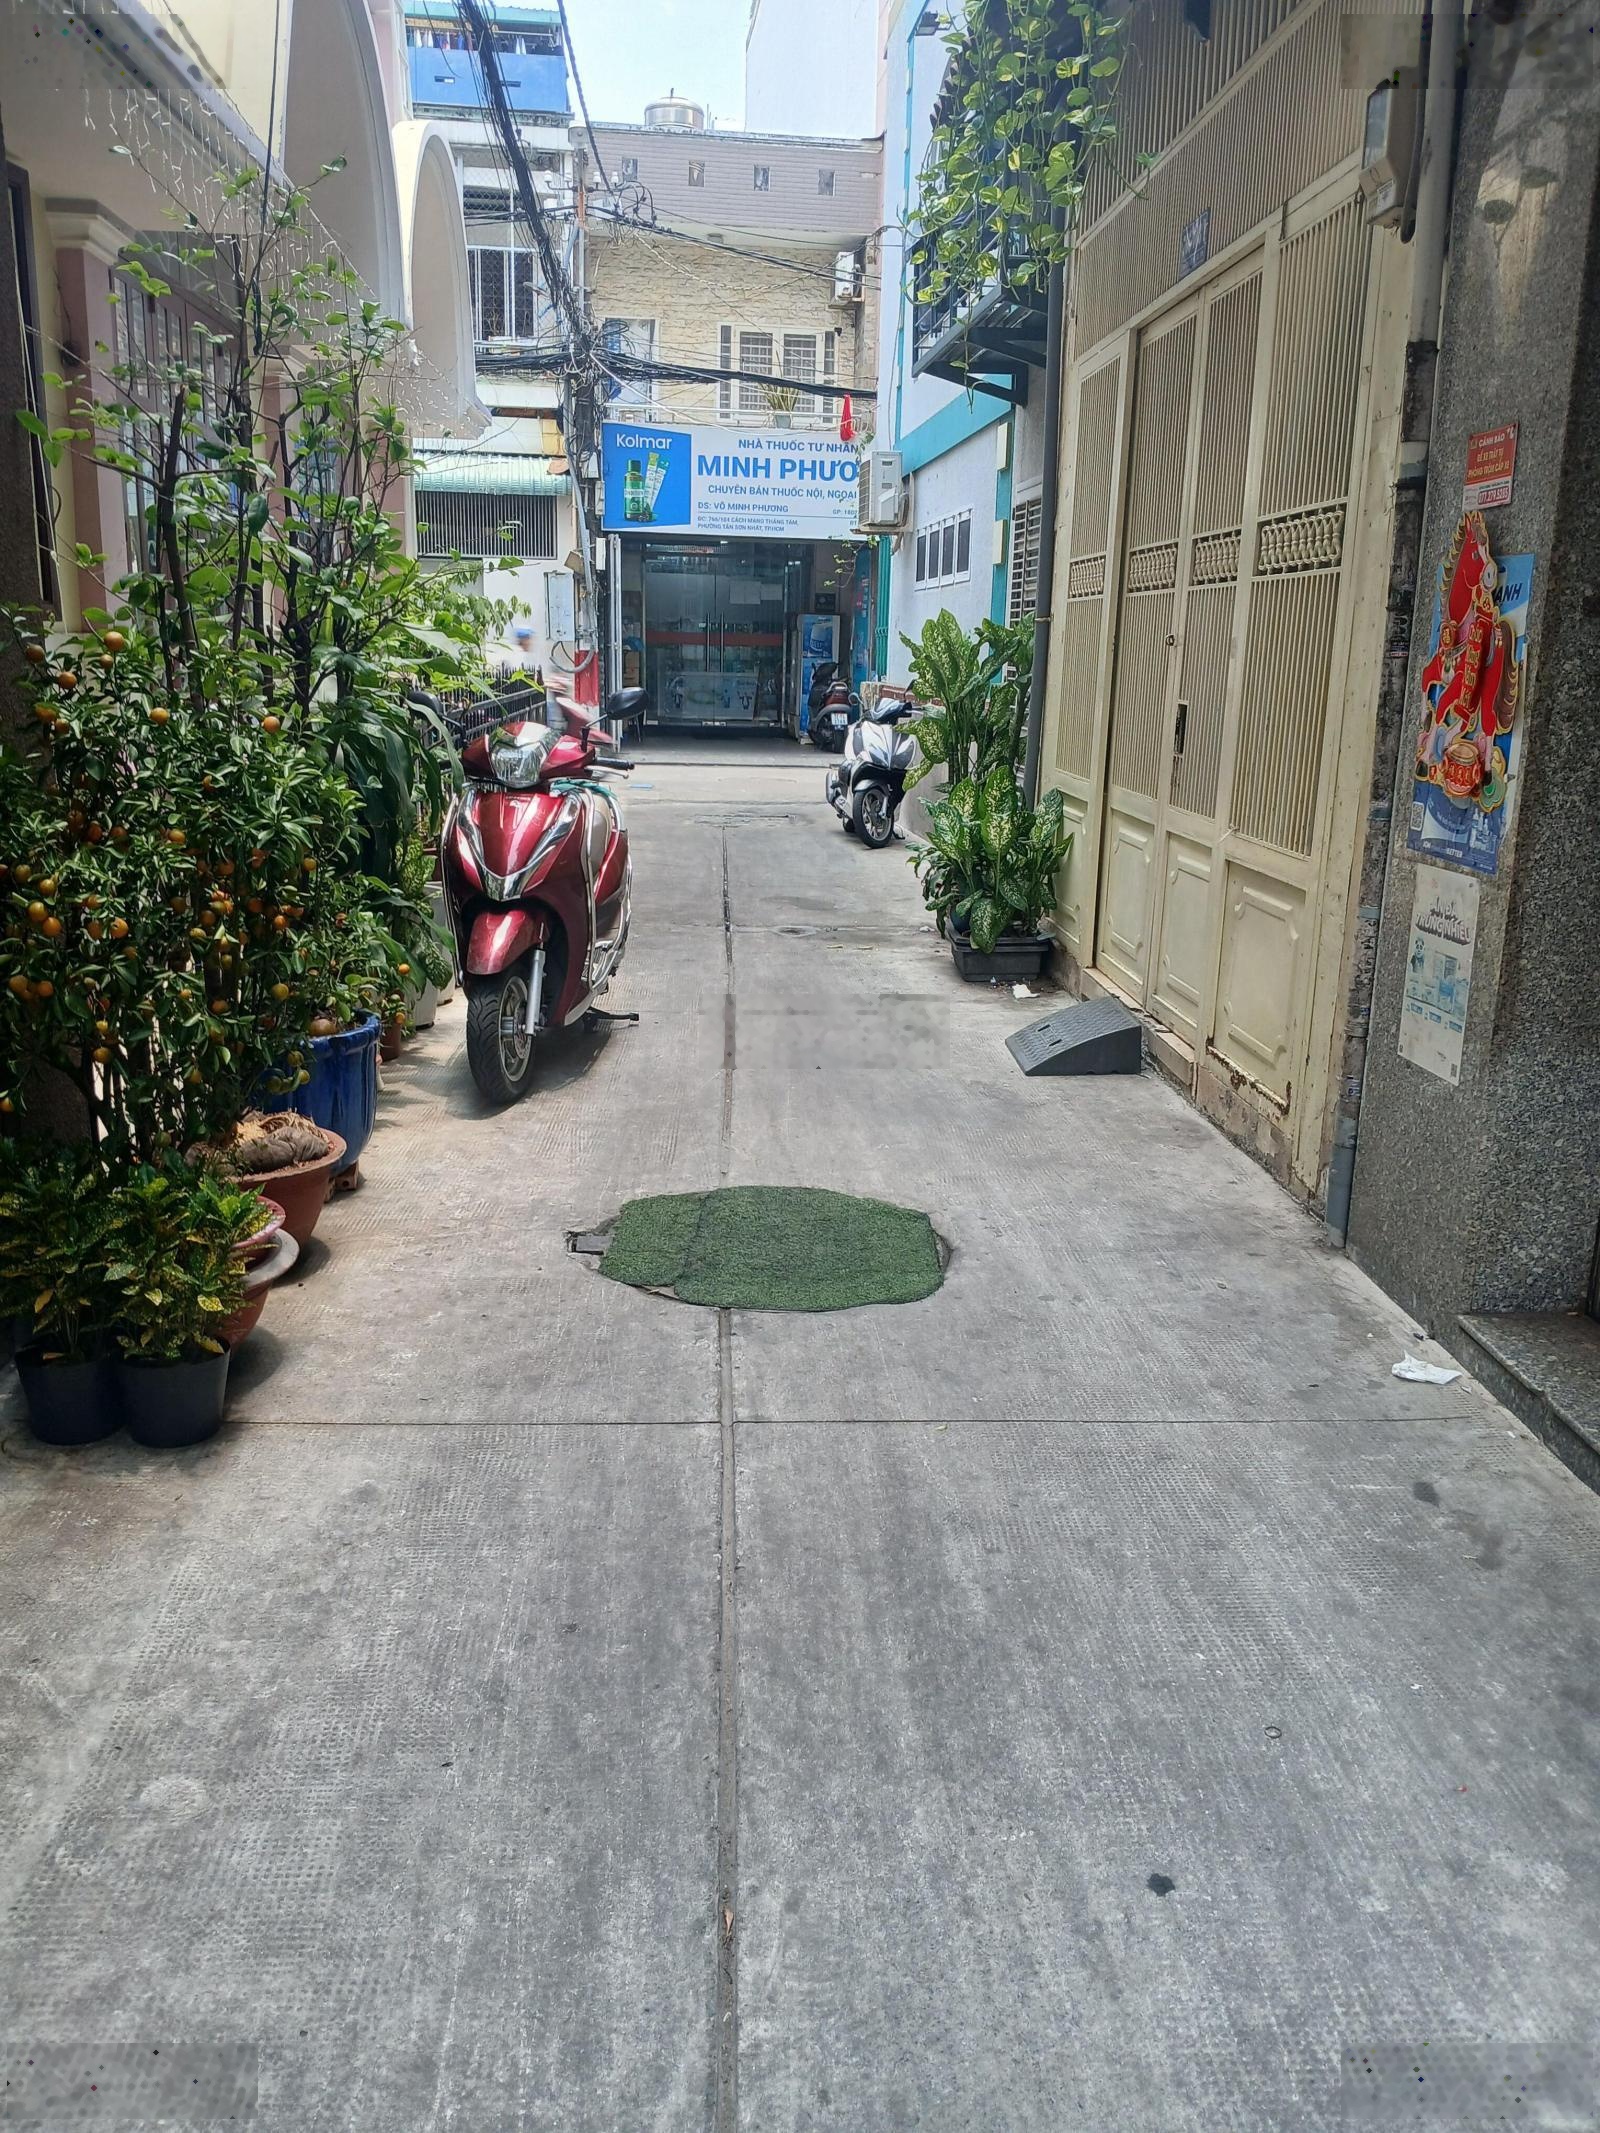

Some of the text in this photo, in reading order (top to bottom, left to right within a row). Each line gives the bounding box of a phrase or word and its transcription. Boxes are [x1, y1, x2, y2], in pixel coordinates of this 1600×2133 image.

[616, 433, 672, 449] Kolmar
[738, 438, 763, 450] NHÀ
[765, 439, 805, 451] THUỐC
[807, 441, 825, 452] TƯ
[697, 454, 859, 482] MINH PHƯƠ
[708, 484, 748, 496] CHUYÊN
[749, 485, 770, 497] BÁN
[772, 485, 804, 498] THUỐC
[806, 487, 825, 500] NỘI,
[697, 501, 789, 513] DS: VÕ MINH PHƯƠNG
